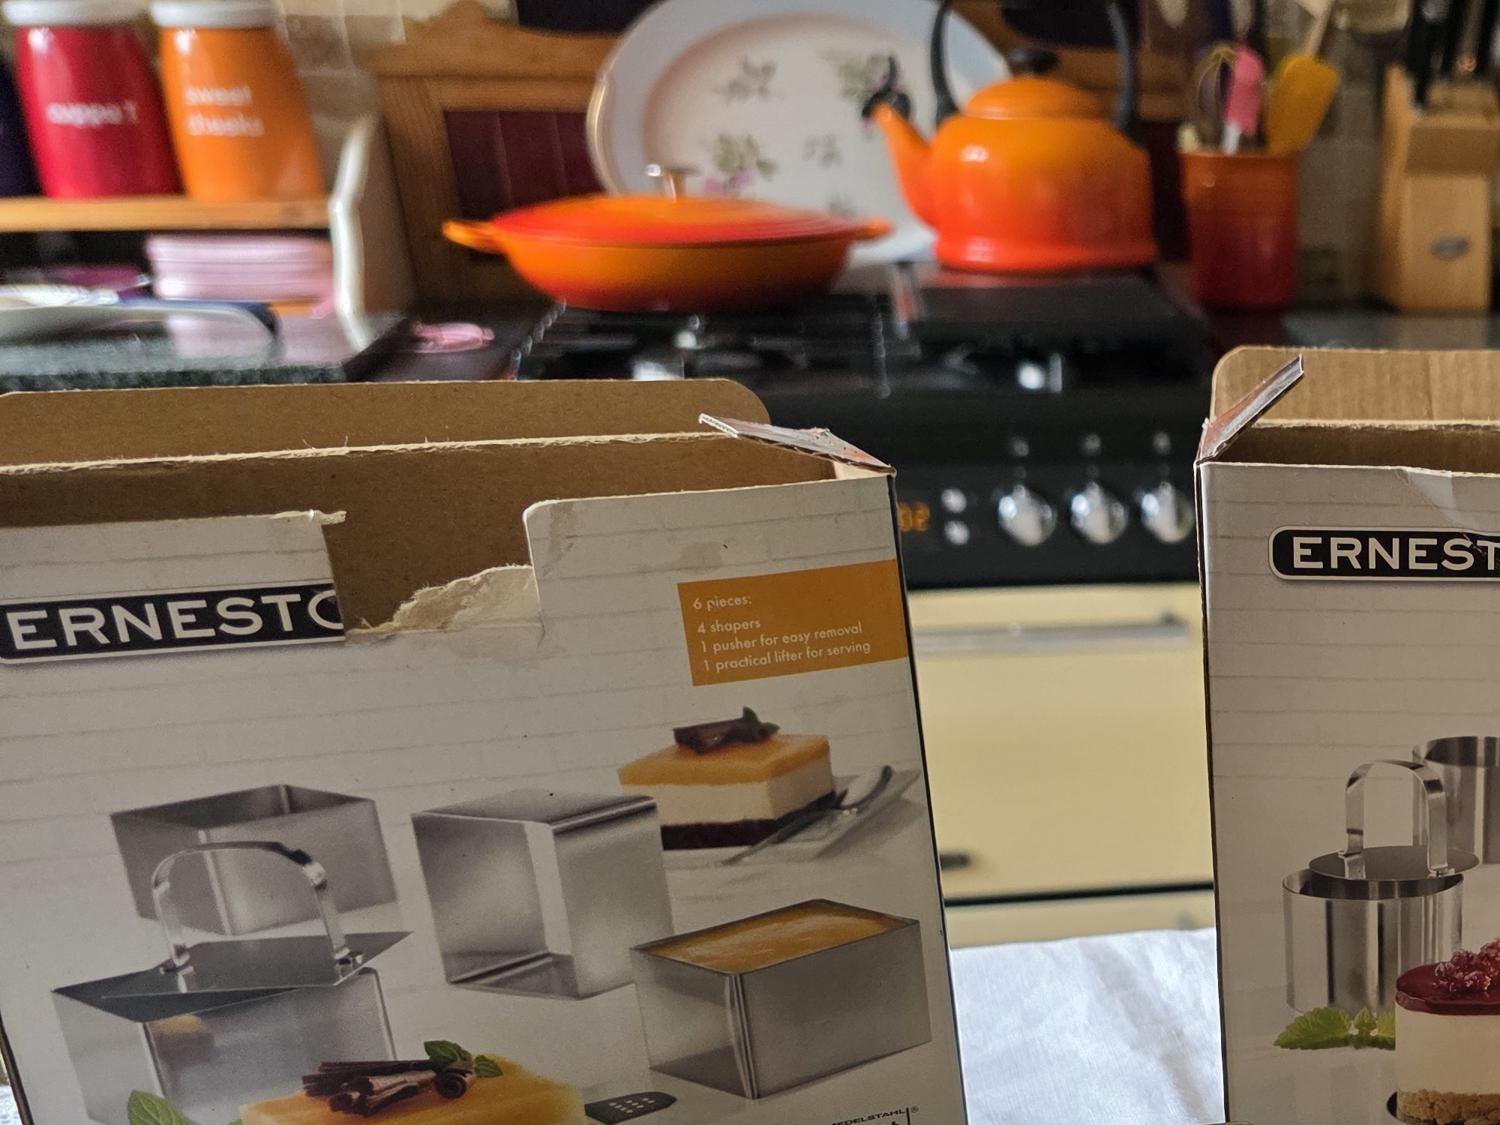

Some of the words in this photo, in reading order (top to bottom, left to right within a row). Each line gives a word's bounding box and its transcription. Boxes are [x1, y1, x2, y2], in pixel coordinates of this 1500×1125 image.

[693, 599, 702, 610] 6
[706, 594, 752, 612] pieces:
[6, 589, 344, 650] ERNESTO
[697, 621, 706, 634] 4
[710, 618, 761, 634] shapers
[701, 640, 707, 653] 1
[713, 635, 757, 654] pusher
[760, 632, 779, 648] for
[782, 631, 811, 645] easy
[814, 621, 863, 641] removal
[704, 659, 710, 672] 1
[715, 654, 772, 674] practical
[774, 650, 803, 666] lifter
[806, 646, 823, 660] for
[826, 642, 871, 658] serving
